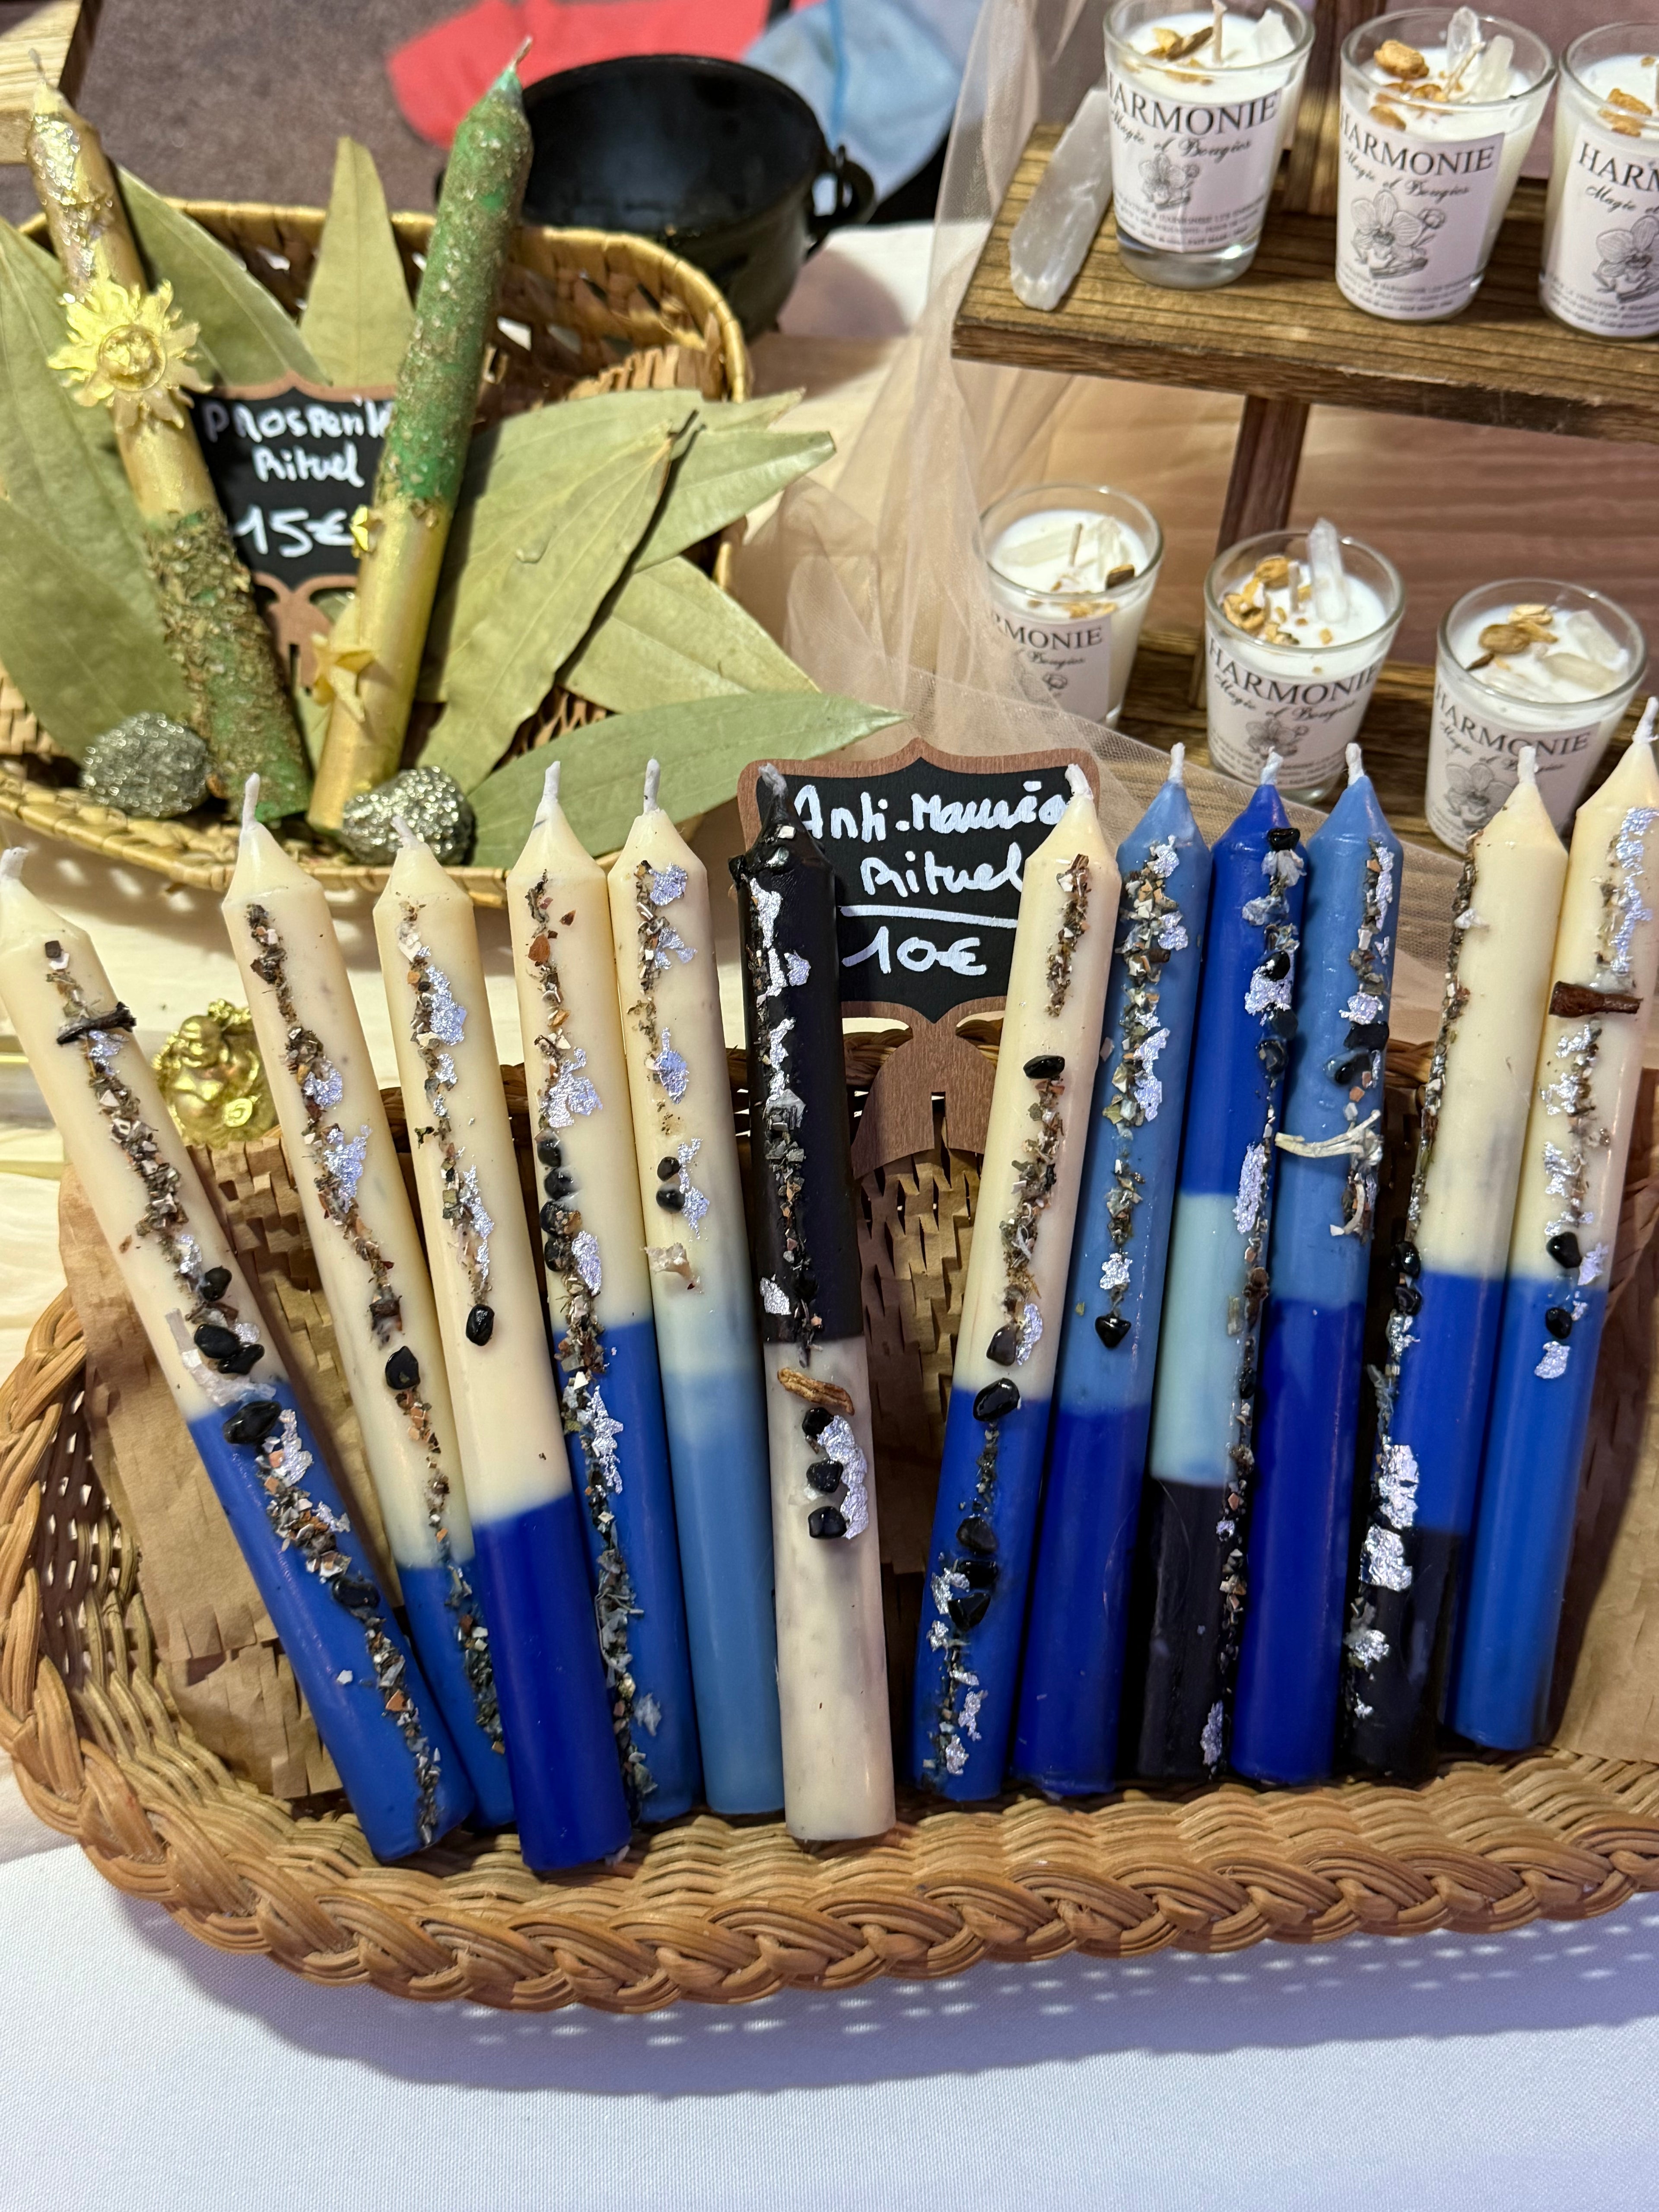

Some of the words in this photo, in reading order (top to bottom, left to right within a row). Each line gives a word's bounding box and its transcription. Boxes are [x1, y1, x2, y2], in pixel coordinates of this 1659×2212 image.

[1585, 184, 1637, 213] Magie
[251, 440, 365, 488] Rituel
[234, 504, 354, 558] 15€
[860, 842, 1023, 897] Rituel
[842, 925, 988, 975] 10€
